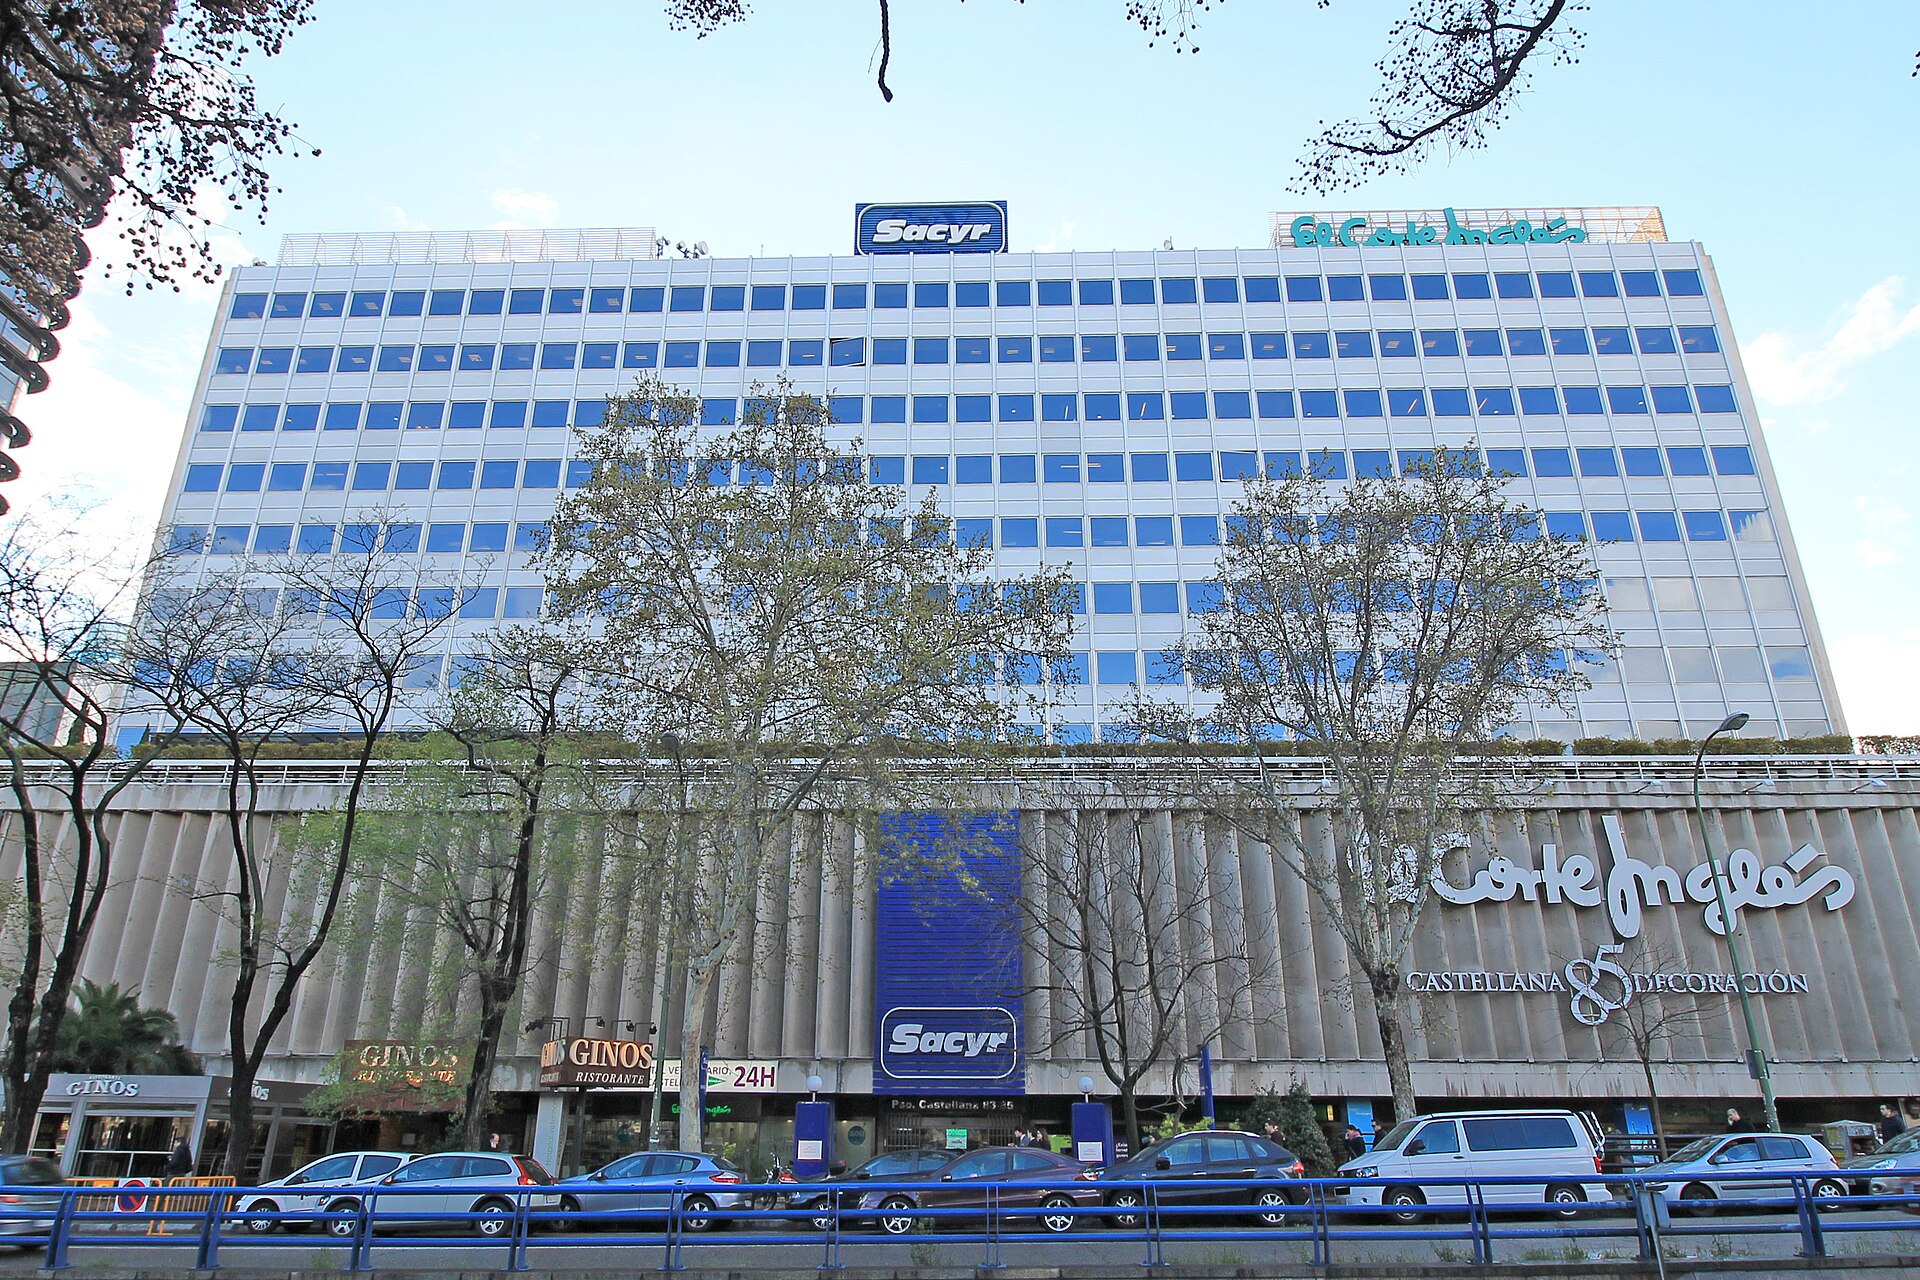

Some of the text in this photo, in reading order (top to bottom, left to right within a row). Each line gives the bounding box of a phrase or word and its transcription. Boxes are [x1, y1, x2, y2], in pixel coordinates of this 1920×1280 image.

[872, 219, 992, 244] Sacyr
[1291, 215, 1337, 247] El
[1339, 217, 1440, 247] Corte
[1430, 832, 1602, 907] Corte
[1602, 815, 1856, 939] Inglés
[1406, 943, 1810, 1025] CASTELLANA 85 DECORACIÓN
[888, 1023, 1009, 1058] Sacyr
[360, 1045, 459, 1068] GINOS
[569, 1038, 653, 1070] GINOS
[65, 1079, 139, 1097] GINOS
[576, 1071, 645, 1085] RISTORANTE
[733, 1066, 776, 1088] 24H
[918, 1099, 980, 1110] Castellana
